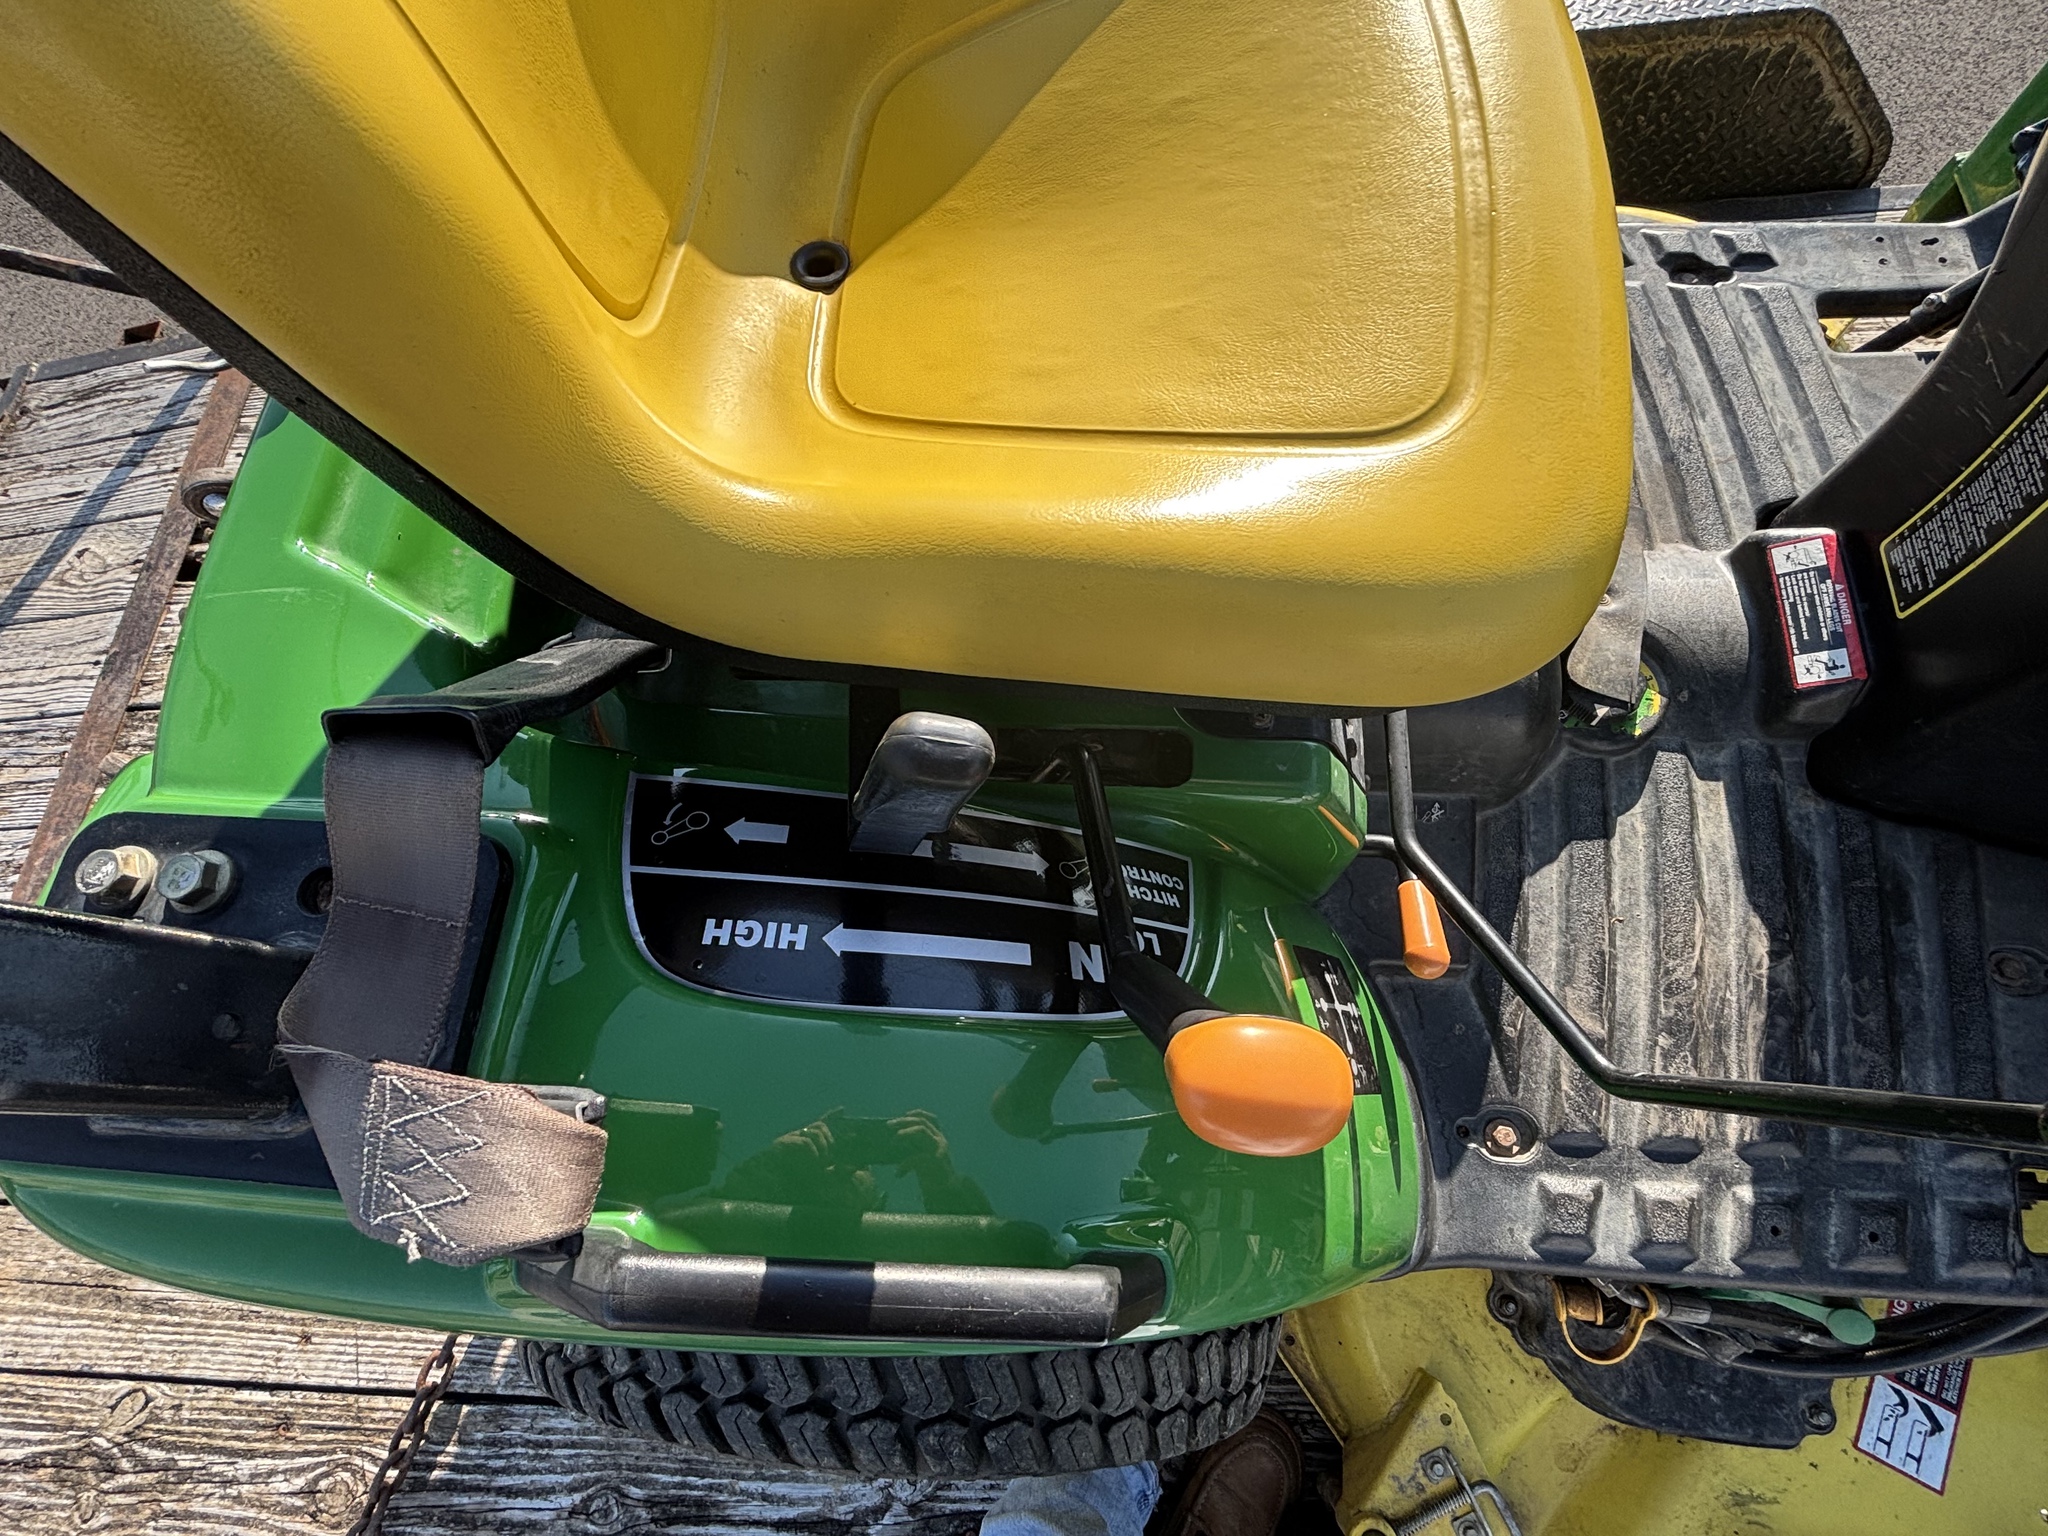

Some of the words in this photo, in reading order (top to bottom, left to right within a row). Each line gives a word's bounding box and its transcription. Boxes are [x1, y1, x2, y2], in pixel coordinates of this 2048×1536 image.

[1836, 591, 1851, 625] DANGER
[1834, 622, 1842, 632] CUT
[702, 917, 809, 952] HIGH
[1068, 941, 1105, 983] N
